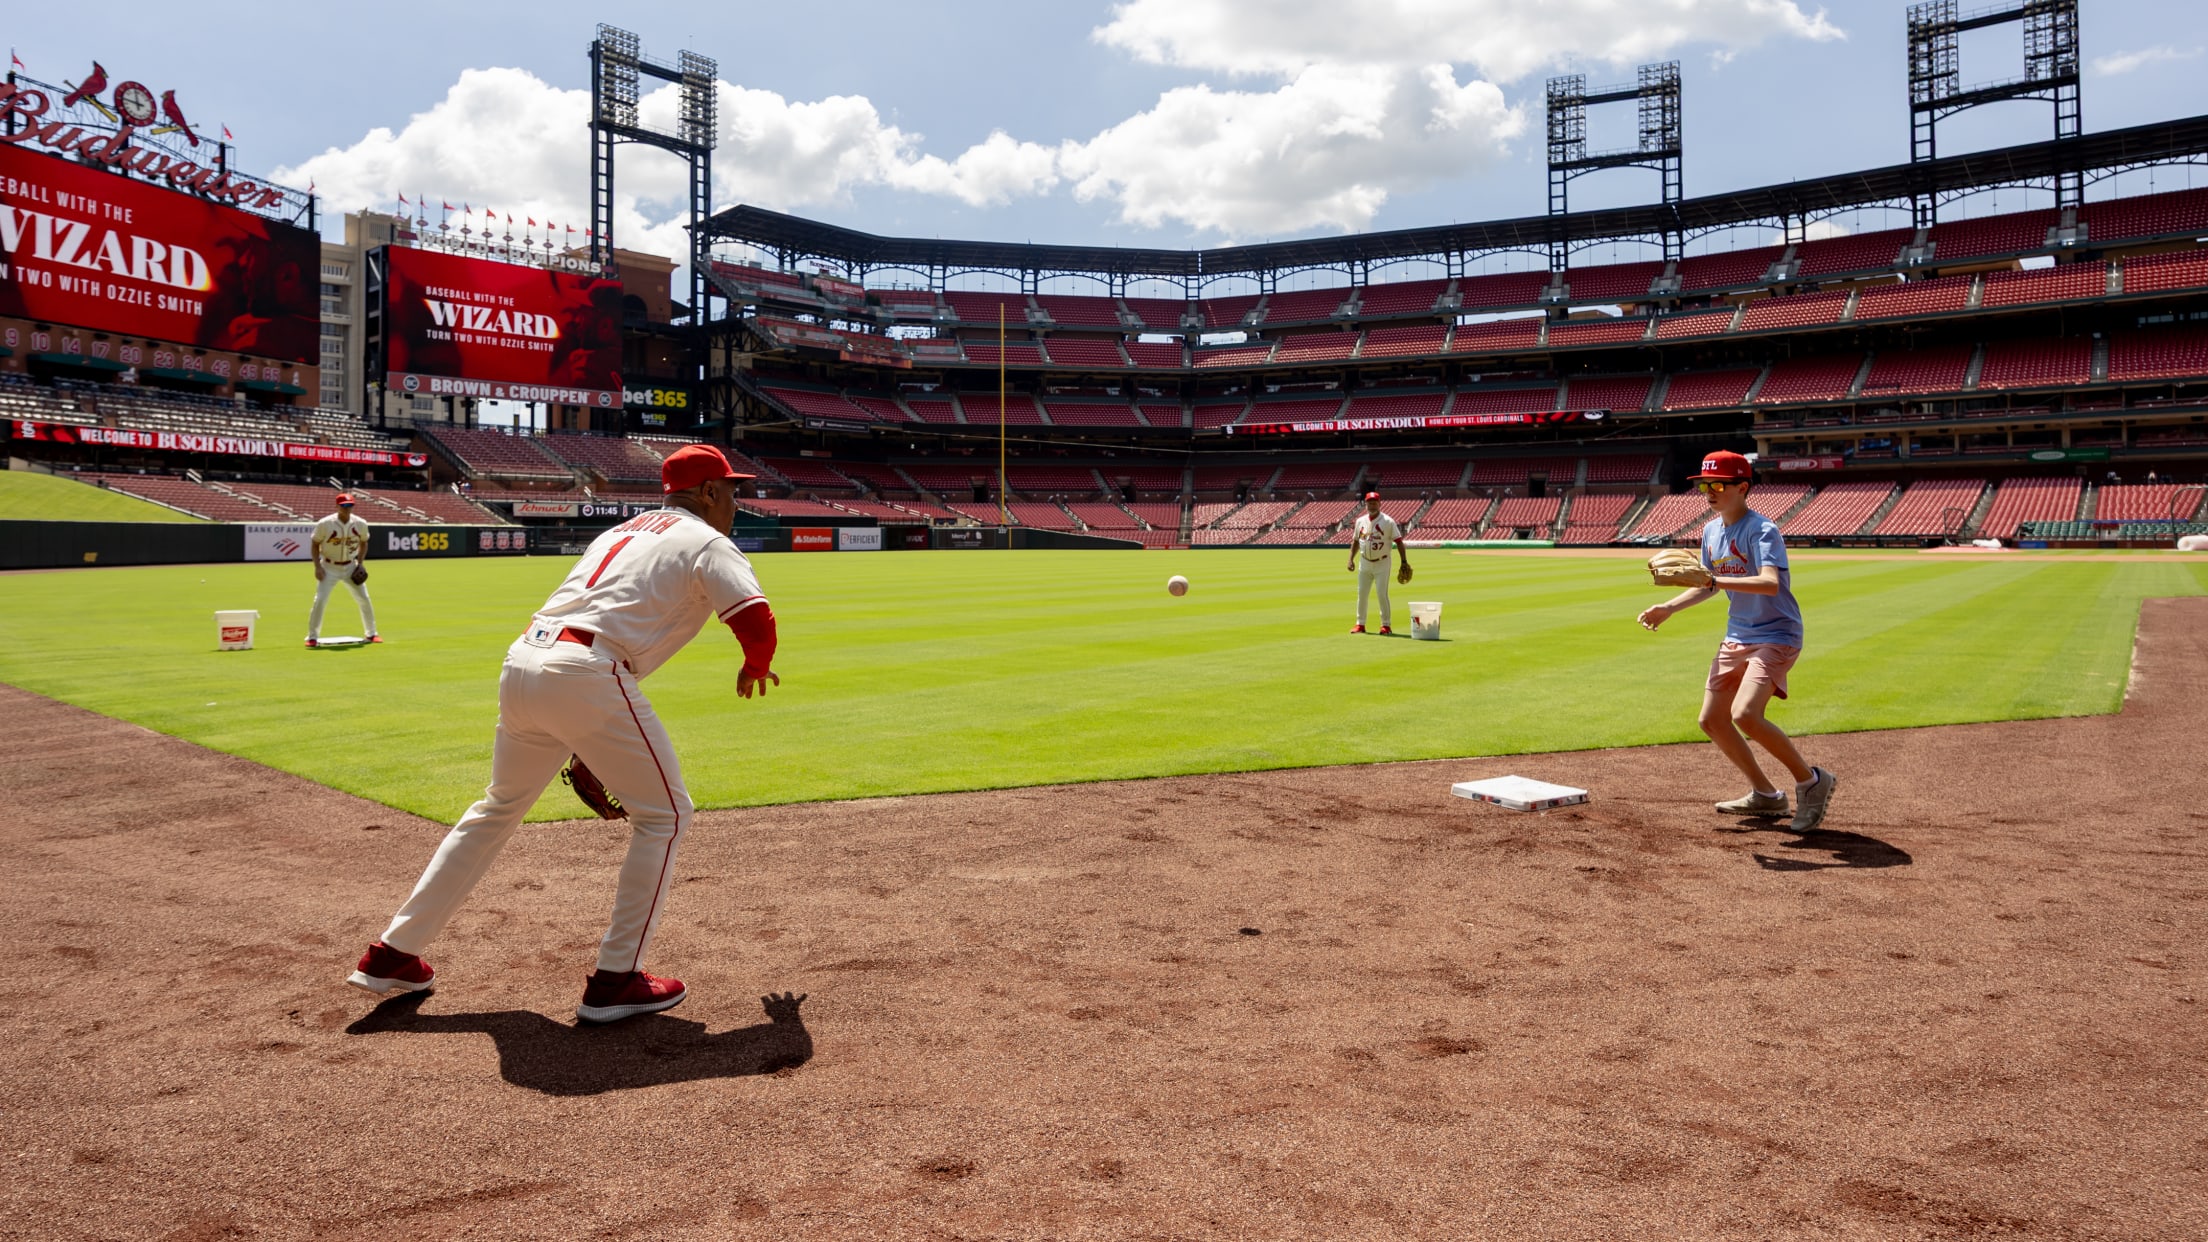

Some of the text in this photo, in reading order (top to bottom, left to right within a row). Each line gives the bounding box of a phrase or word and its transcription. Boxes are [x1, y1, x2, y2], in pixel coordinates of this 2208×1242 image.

[0, 82, 283, 208] Budweiser
[56, 190, 97, 215] WITH
[103, 202, 133, 225] THE
[416, 231, 601, 273] WORLD CHAMPIONS
[16, 266, 52, 288] TWO
[59, 274, 100, 297] WITH
[107, 284, 152, 306] OZZIE
[158, 294, 203, 316] SMITH
[425, 286, 515, 307] BASEBALL WITH THE
[424, 299, 561, 339] WIZARD
[5, 328, 19, 347] 9
[31, 332, 50, 351] 10
[62, 336, 80, 354] 14
[92, 341, 110, 358] 17
[120, 346, 142, 364] 20
[154, 350, 175, 369] 23
[182, 355, 202, 371] 24
[211, 360, 231, 377] 42
[426, 329, 554, 352] TURN TWO WITH OZZIE SMITH
[431, 378, 588, 404] BROWN & CROUPPEN
[622, 385, 687, 408] bet365
[1293, 422, 1324, 431] WELCOME
[1325, 422, 1334, 430] TO
[1337, 419, 1373, 430] BUSCH
[1374, 416, 1426, 429] STADIUM
[1429, 417, 1444, 425] HOME
[1453, 416, 1467, 424] YOUR
[1476, 415, 1492, 423] LOUIS
[1493, 414, 1524, 423] CARDINALS
[80, 428, 136, 446] WELCOME
[138, 432, 152, 446] TO
[157, 432, 215, 452] BUSCH
[216, 437, 285, 457] STADIUM
[288, 446, 307, 456] HOME
[344, 450, 361, 460] LOUIS
[361, 452, 392, 463] CARDINALS
[1702, 460, 1717, 470] STL
[595, 506, 618, 515] 11:45
[274, 526, 285, 534] OF
[388, 531, 449, 551] bet365
[1371, 542, 1385, 551] 37
[586, 535, 634, 589] 1
